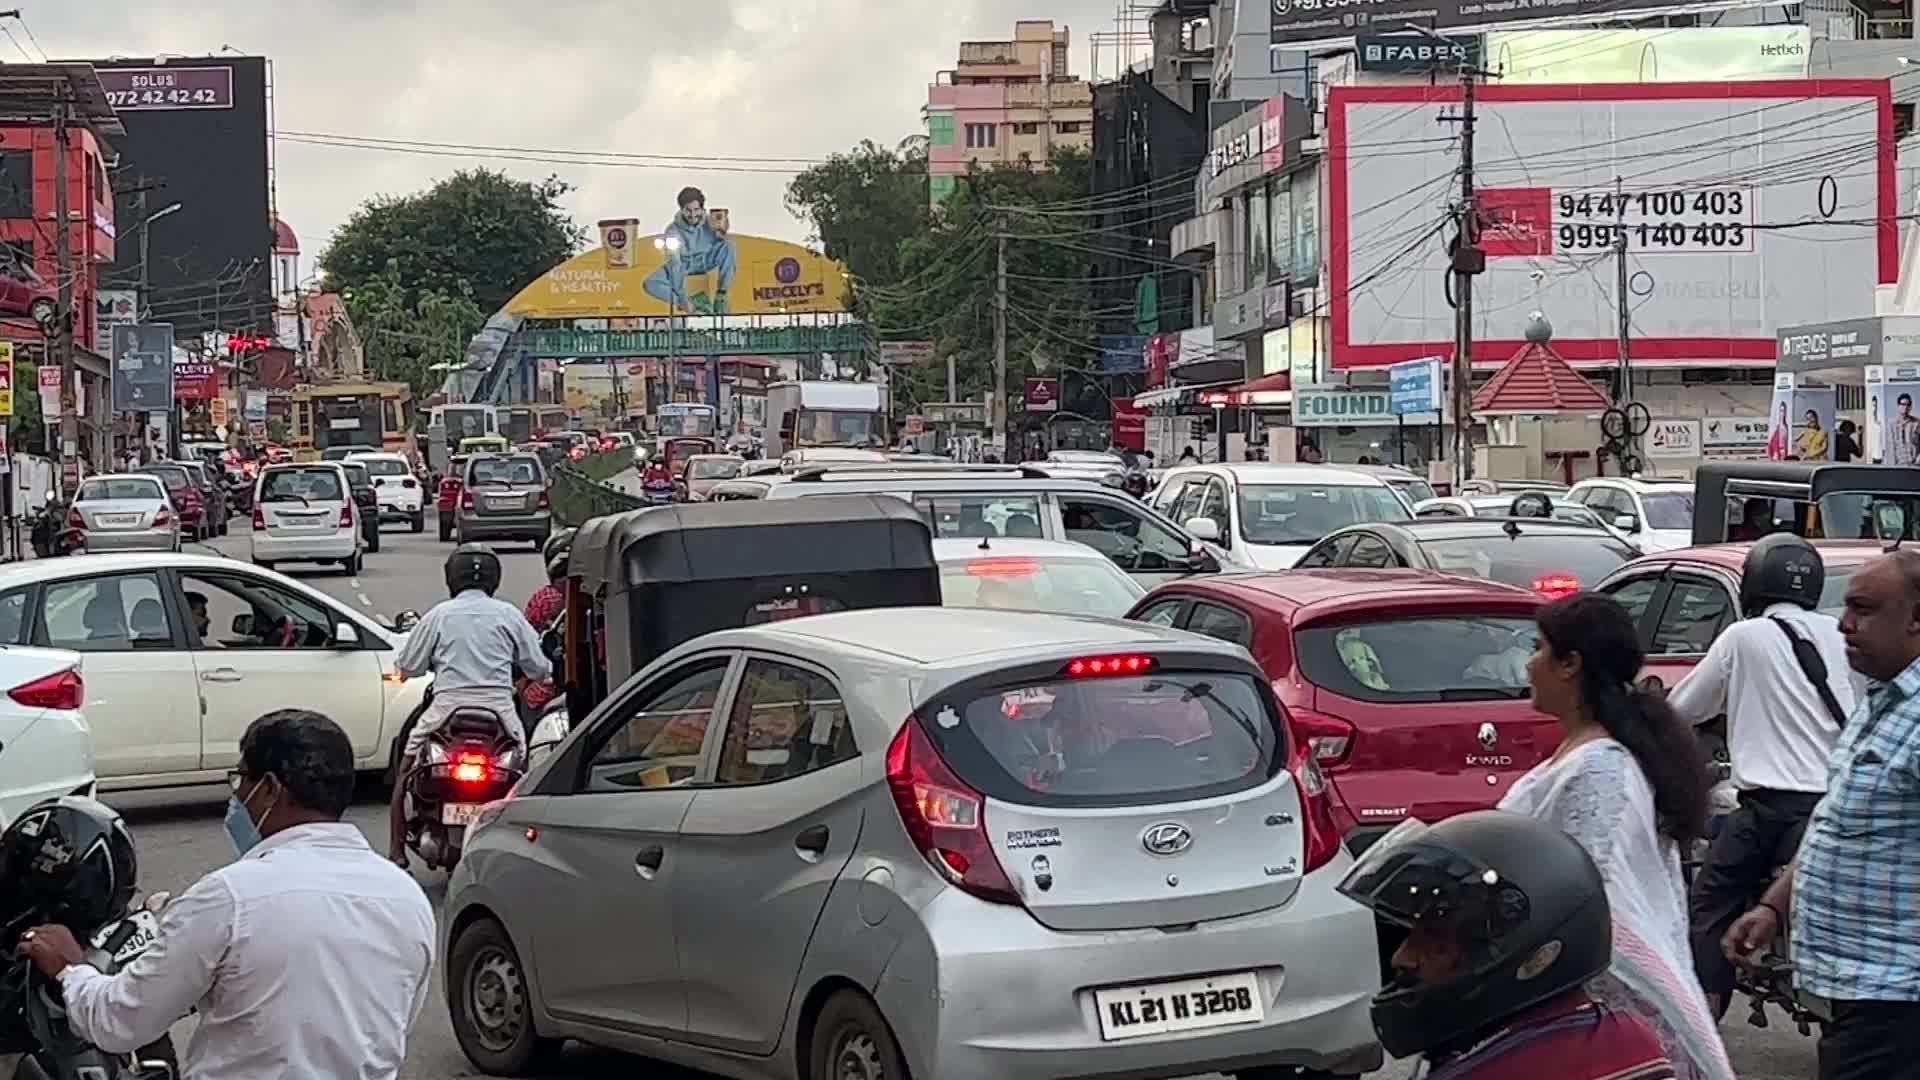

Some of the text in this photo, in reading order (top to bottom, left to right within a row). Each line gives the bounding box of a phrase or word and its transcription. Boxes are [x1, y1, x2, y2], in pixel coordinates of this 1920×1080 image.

[1386, 45, 1467, 61] FABER
[131, 75, 174, 87] SOLUS
[142, 90, 164, 104] 42
[167, 89, 190, 103] 42
[193, 89, 216, 103] 42
[1692, 190, 1743, 216] 403
[1559, 223, 1627, 249] 9995
[1635, 222, 1687, 247] 140
[1692, 221, 1744, 247] 403
[1361, 808, 1407, 816] RENAULT
[1171, 994, 1190, 1019] H
[1191, 987, 1252, 1016] 3268
